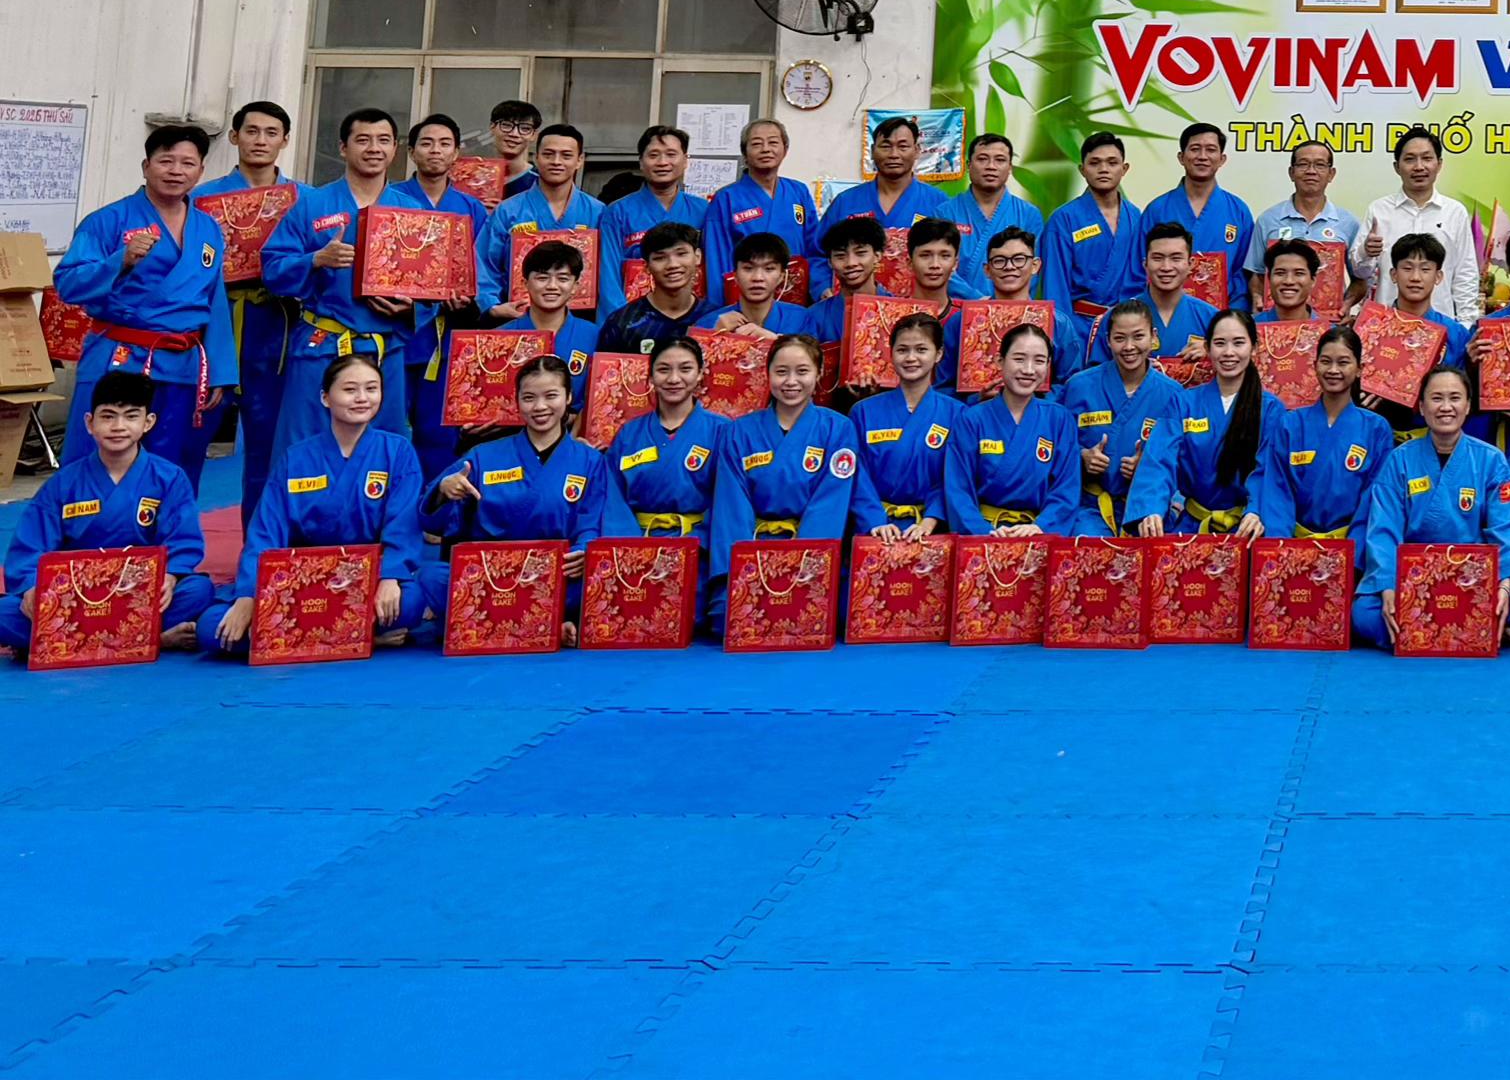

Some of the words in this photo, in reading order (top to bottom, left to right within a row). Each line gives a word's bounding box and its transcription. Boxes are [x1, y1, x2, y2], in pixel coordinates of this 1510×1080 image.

[1098, 23, 1456, 110] VOVINAM
[1229, 114, 1373, 152] THÀNH
[630, 452, 643, 463] VY
[77, 503, 98, 514] NAM
